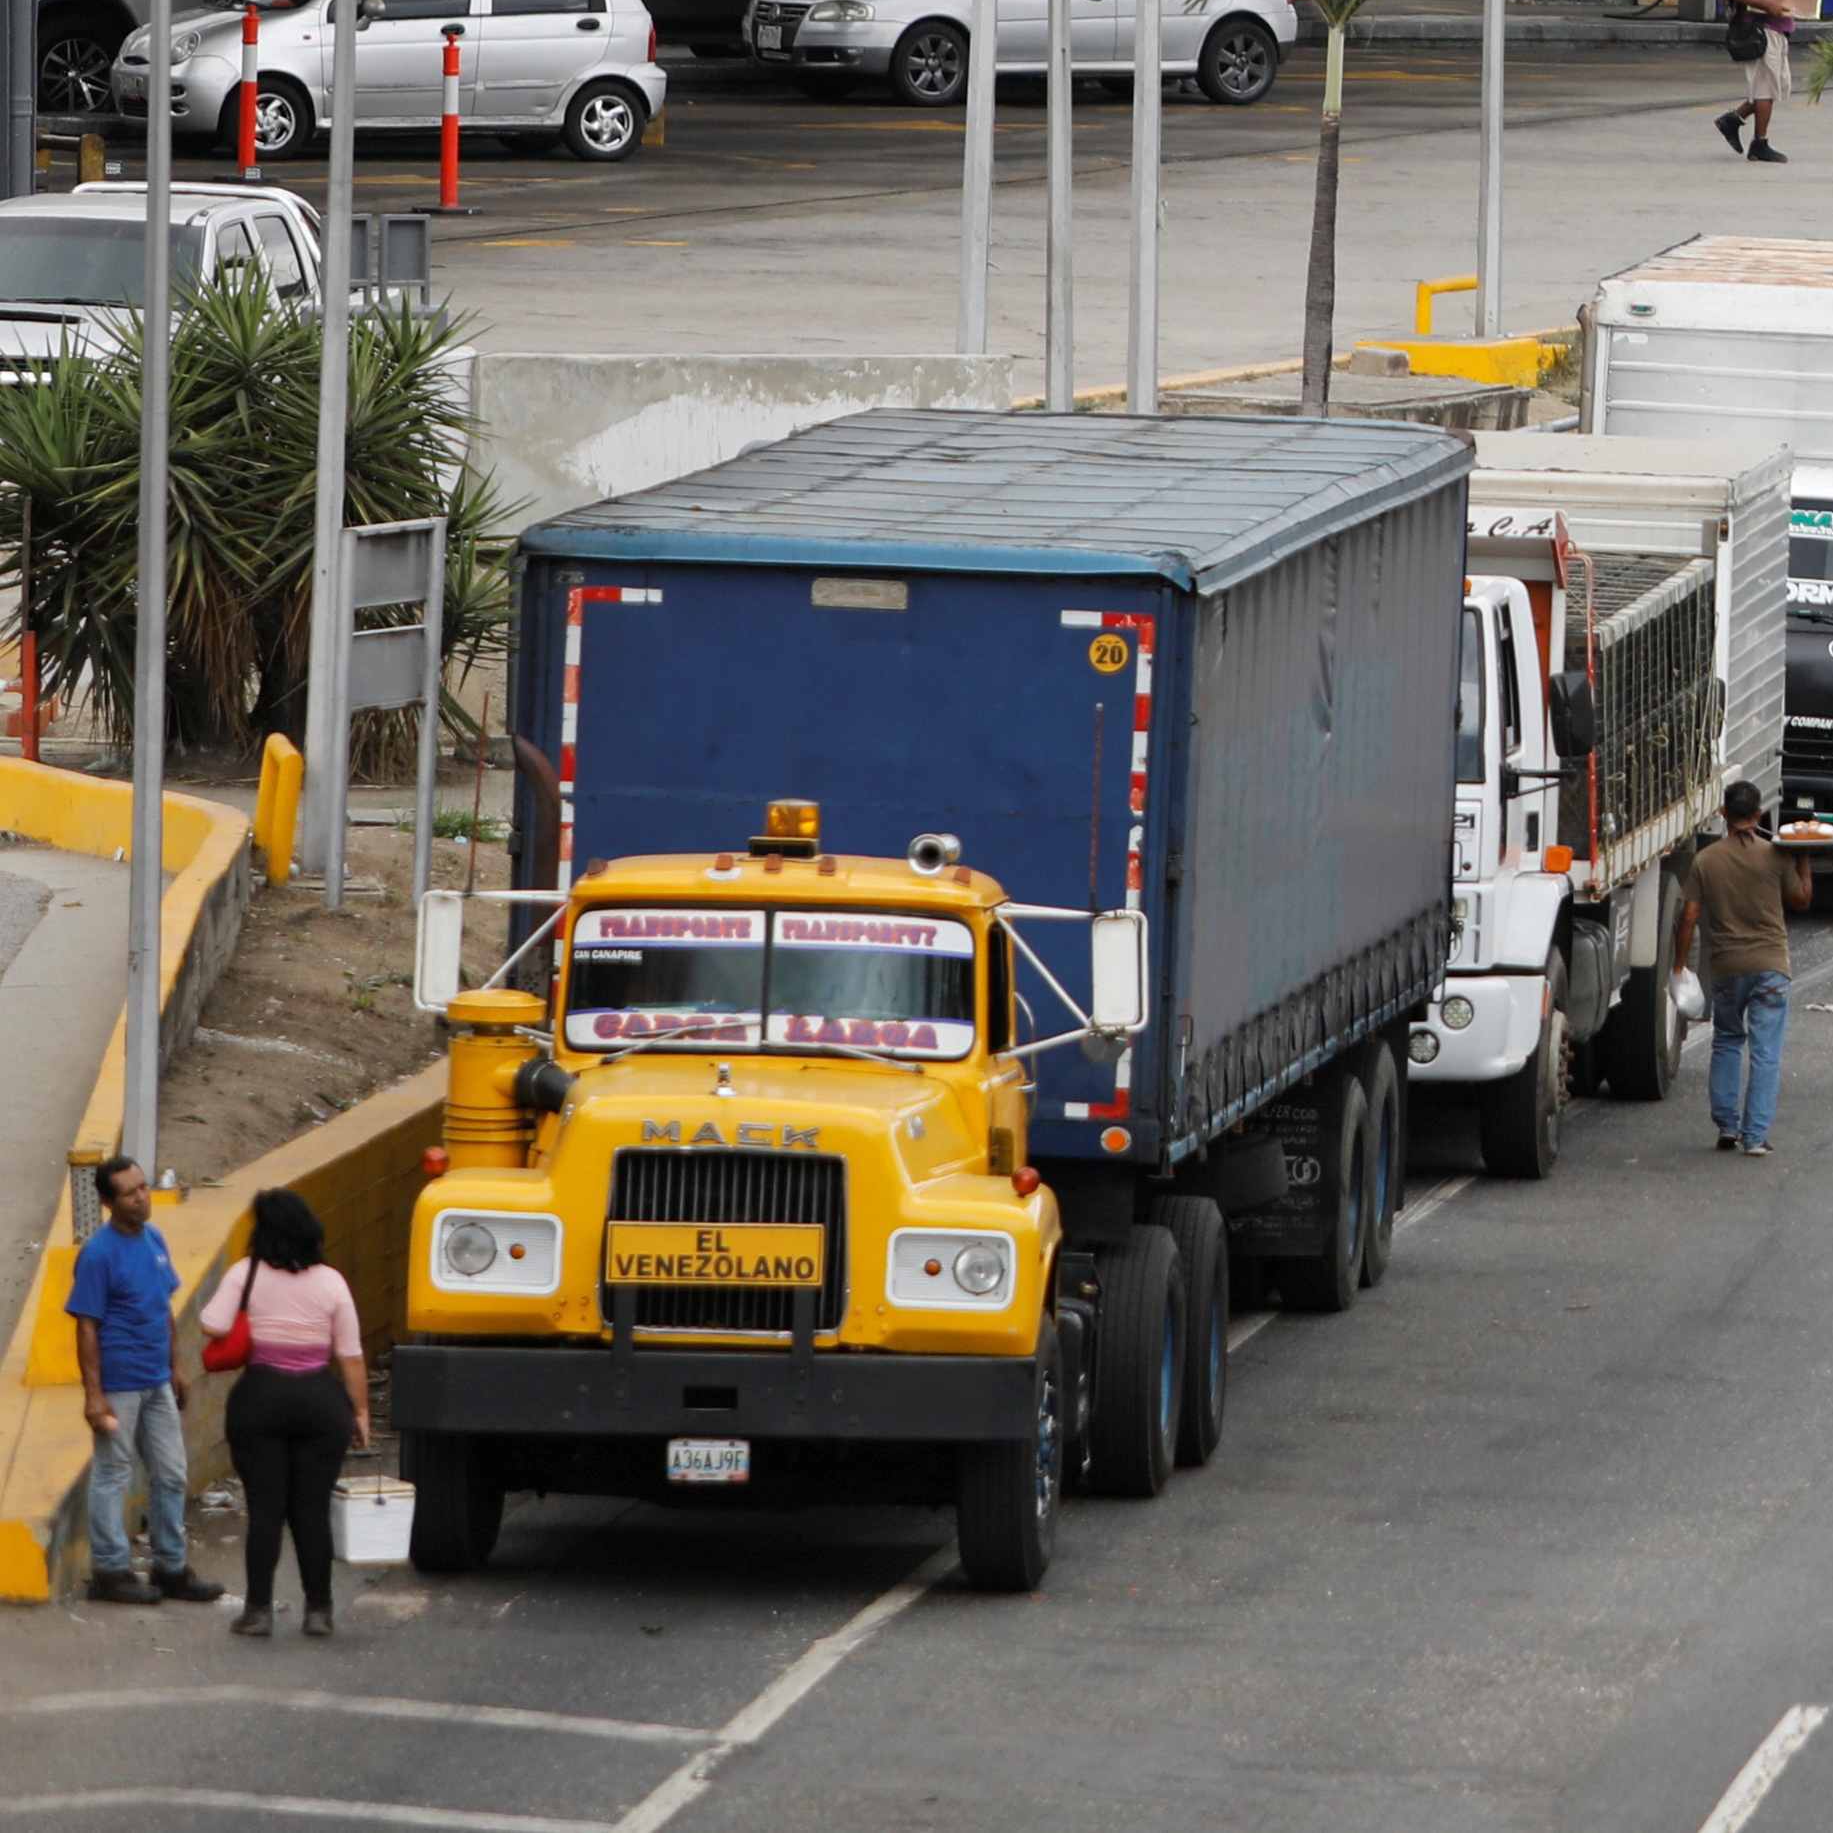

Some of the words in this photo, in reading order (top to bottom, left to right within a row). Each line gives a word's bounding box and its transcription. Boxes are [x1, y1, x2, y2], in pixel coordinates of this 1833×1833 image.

[1095, 645, 1123, 664] 20
[600, 915, 752, 939] TRANSPORTE
[641, 1118, 821, 1147] MACK
[696, 1230, 730, 1253] EL
[615, 1254, 816, 1280] VENEZOLANO
[673, 1449, 745, 1471] A36AJ9F
